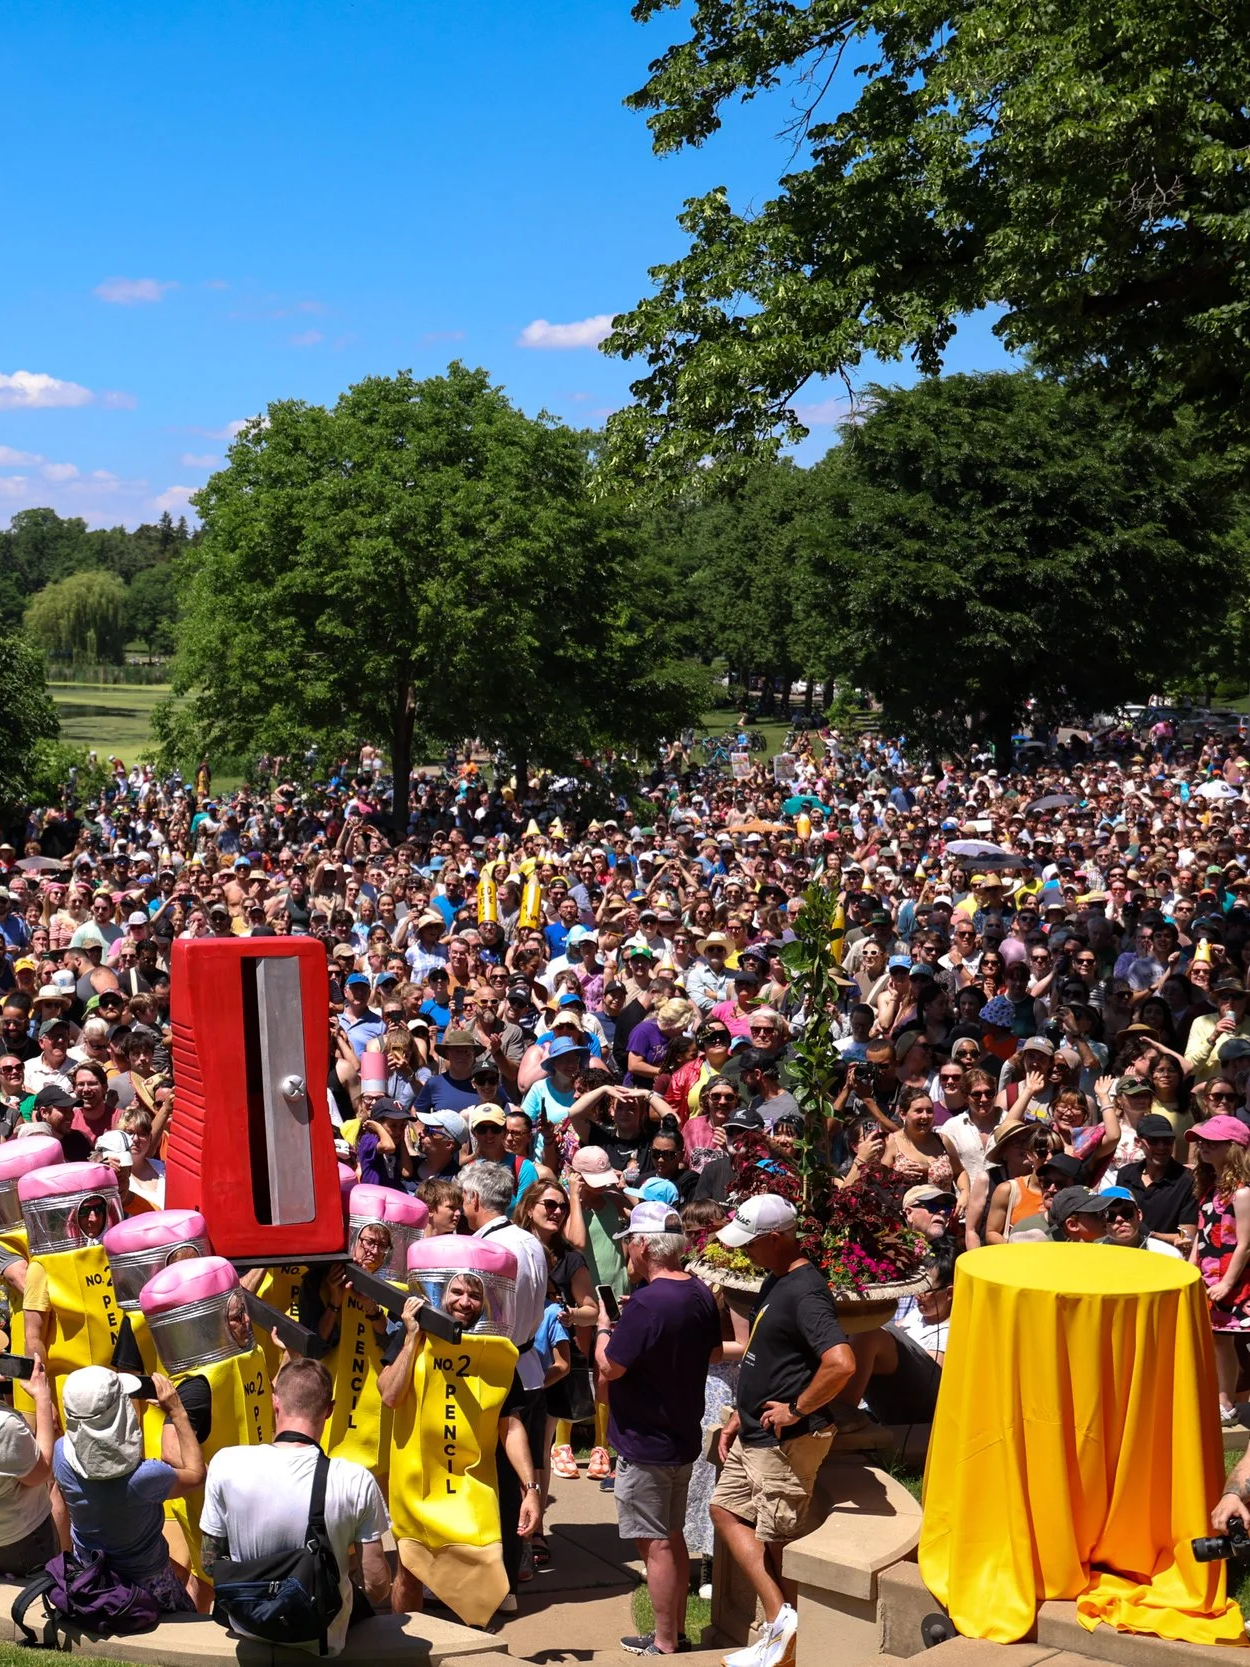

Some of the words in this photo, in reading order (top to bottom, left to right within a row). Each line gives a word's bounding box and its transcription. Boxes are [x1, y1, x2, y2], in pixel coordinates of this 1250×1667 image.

[85, 1273, 104, 1287] NO.
[348, 1322, 365, 1429] PENCIL
[433, 1358, 454, 1371] NO.
[456, 1355, 470, 1378] 2
[244, 1381, 256, 1396] NO.
[257, 1372, 264, 1396] 2
[444, 1384, 457, 1494] PENCIL
